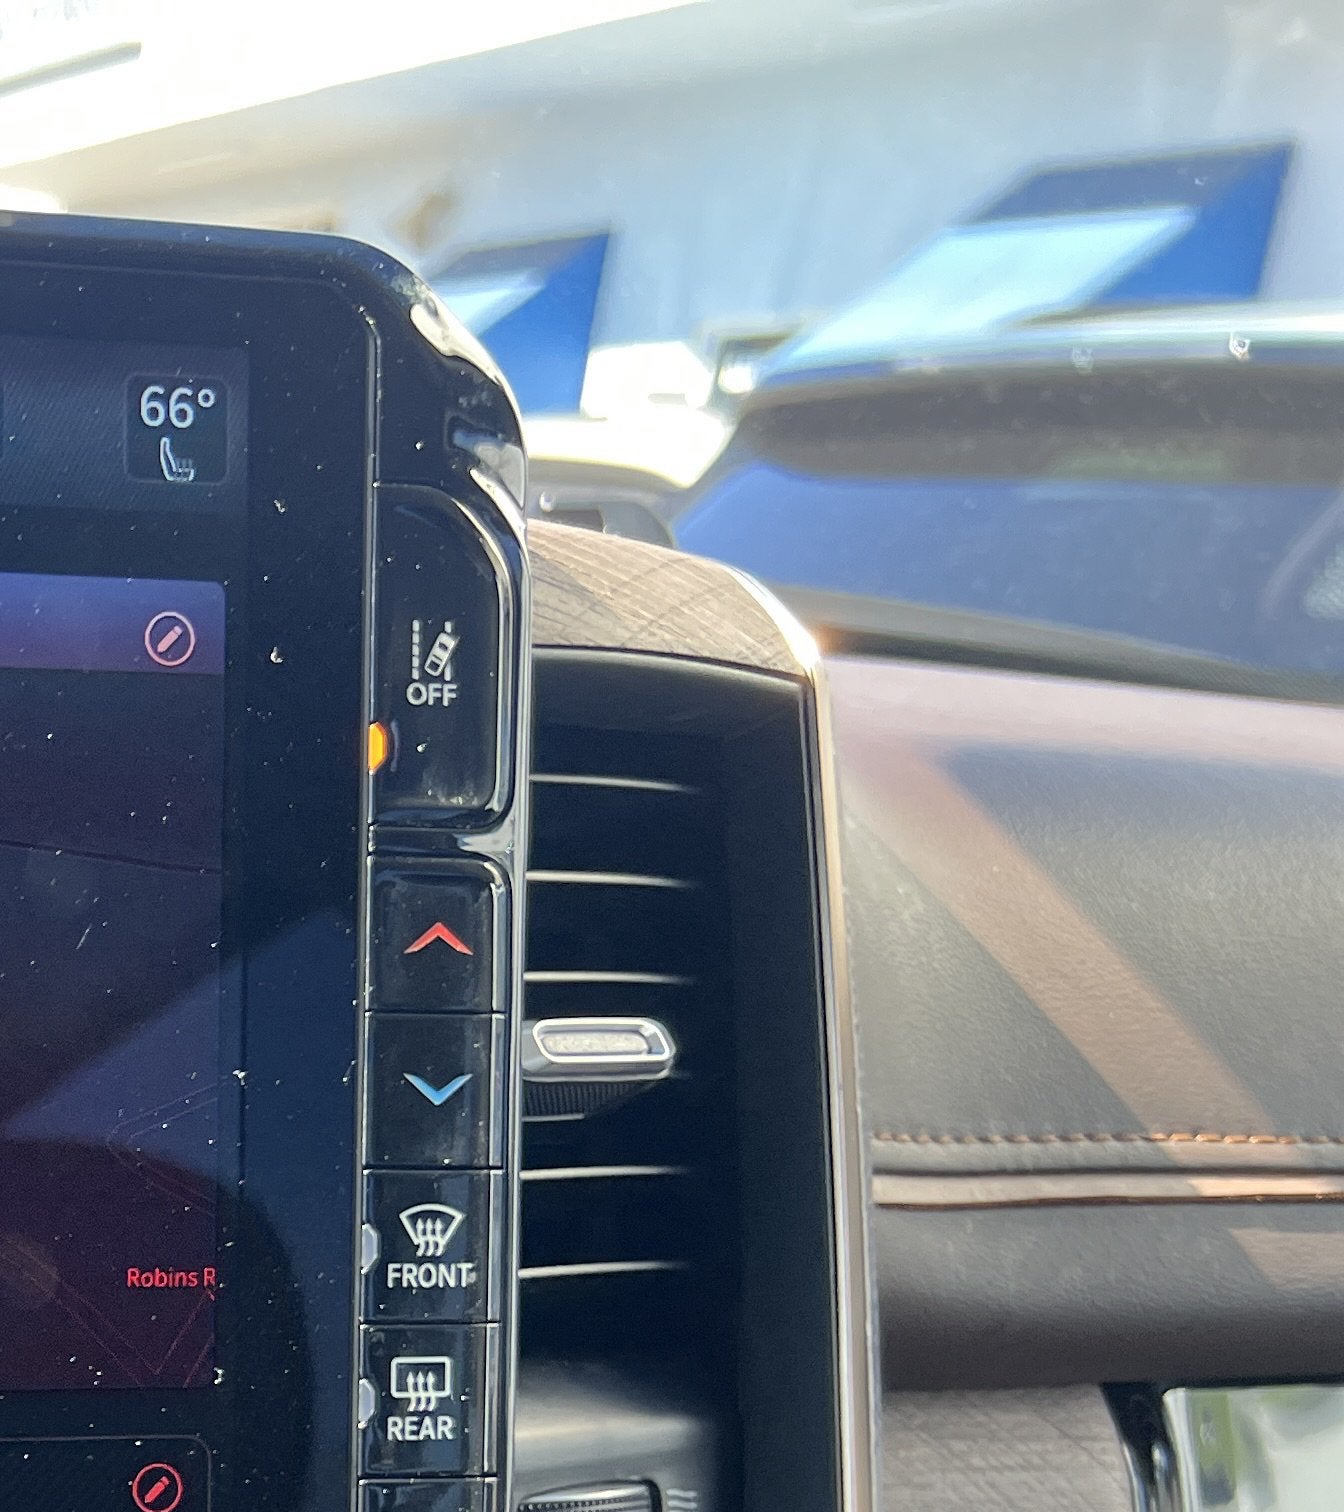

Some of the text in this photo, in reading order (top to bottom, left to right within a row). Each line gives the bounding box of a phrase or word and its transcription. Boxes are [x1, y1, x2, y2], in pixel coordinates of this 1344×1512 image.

[406, 681, 458, 707] OFF
[127, 1267, 198, 1287] Robins
[387, 1262, 472, 1289] FRONT
[387, 1415, 454, 1441] REAR
